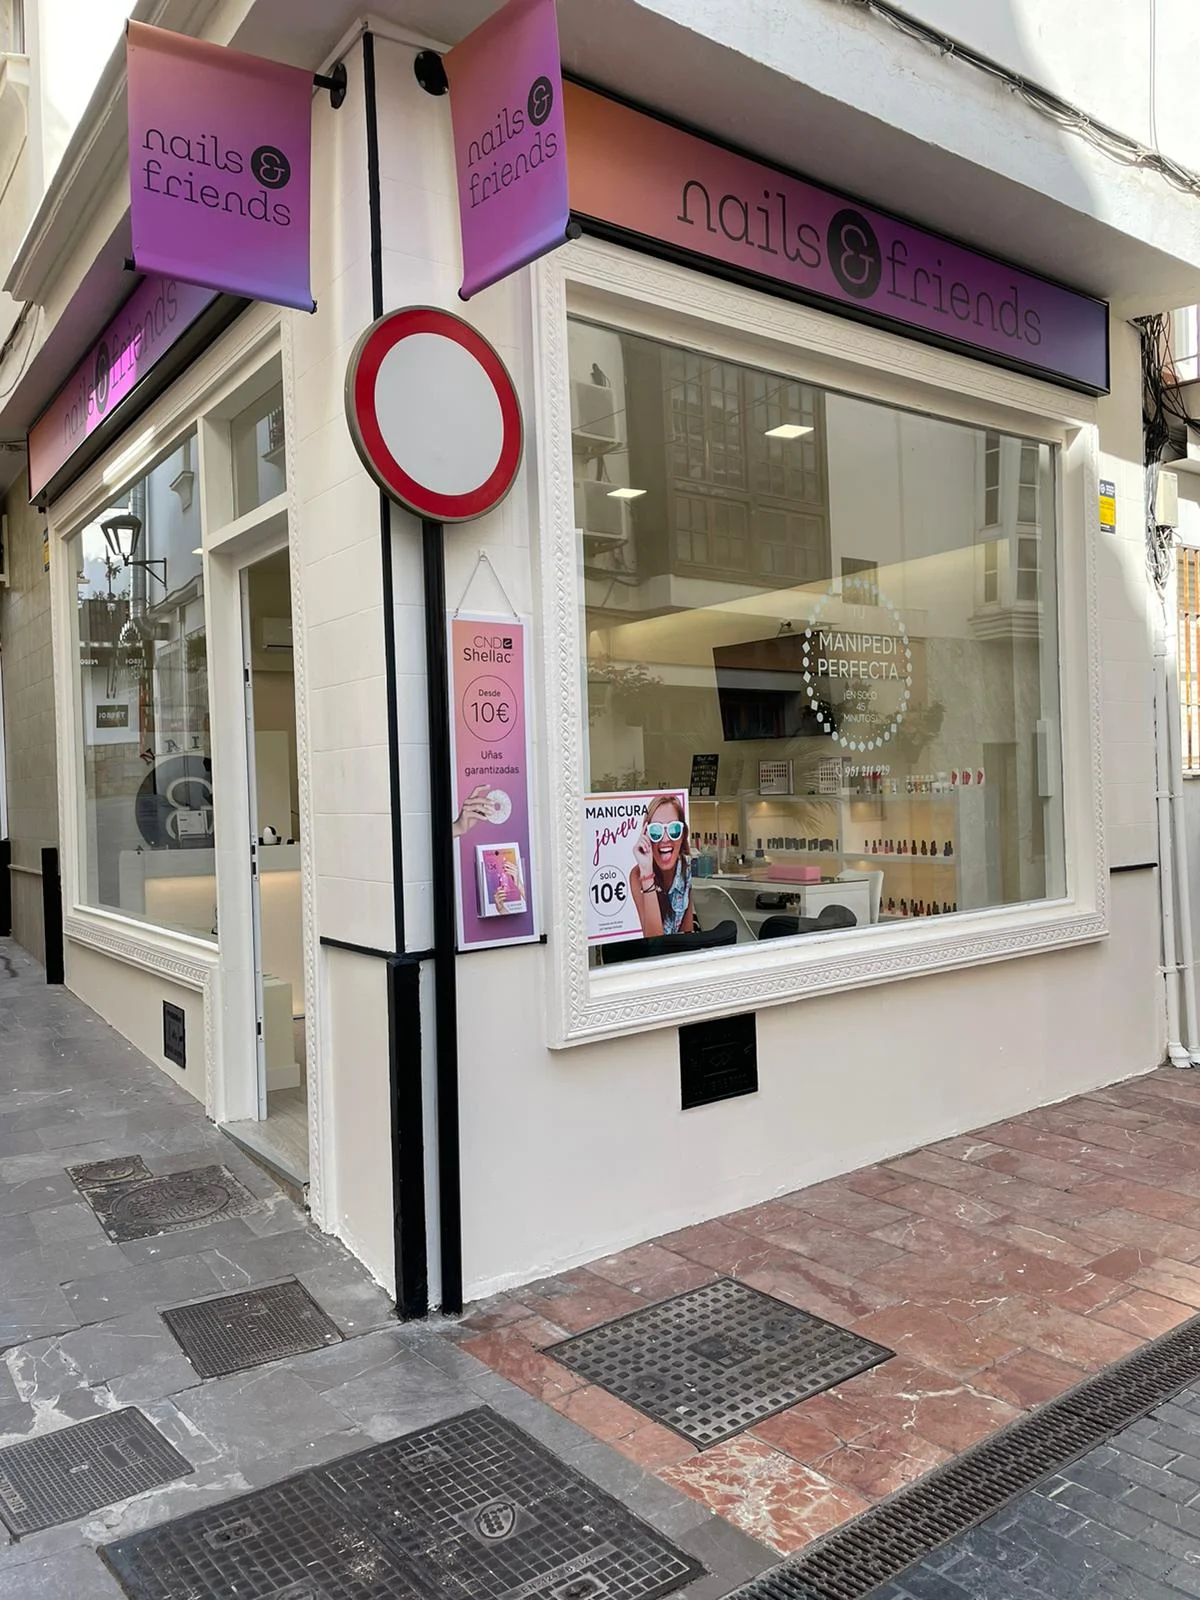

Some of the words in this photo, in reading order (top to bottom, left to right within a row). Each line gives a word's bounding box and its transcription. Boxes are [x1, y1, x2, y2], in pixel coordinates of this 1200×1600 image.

[467, 107, 525, 168] nails
[531, 83, 551, 120] &
[142, 128, 244, 174] nails
[258, 151, 287, 185] &
[469, 131, 558, 209] friends
[142, 159, 292, 226] friends
[676, 179, 822, 269] nails
[837, 220, 877, 288] &
[885, 239, 1043, 346] friends
[63, 375, 96, 445] nails
[473, 635, 503, 649] CND
[819, 631, 897, 655] MANIPEDI
[463, 647, 512, 664] Shellac
[817, 657, 899, 681] PERFECTA
[478, 688, 501, 697] Desde
[471, 701, 510, 723] 10€
[481, 749, 503, 760] Uñas
[464, 765, 520, 777] garantizadas
[585, 804, 649, 819] MANICURA
[592, 817, 638, 867] joven
[599, 870, 617, 880] solo
[591, 881, 627, 904] 10€
